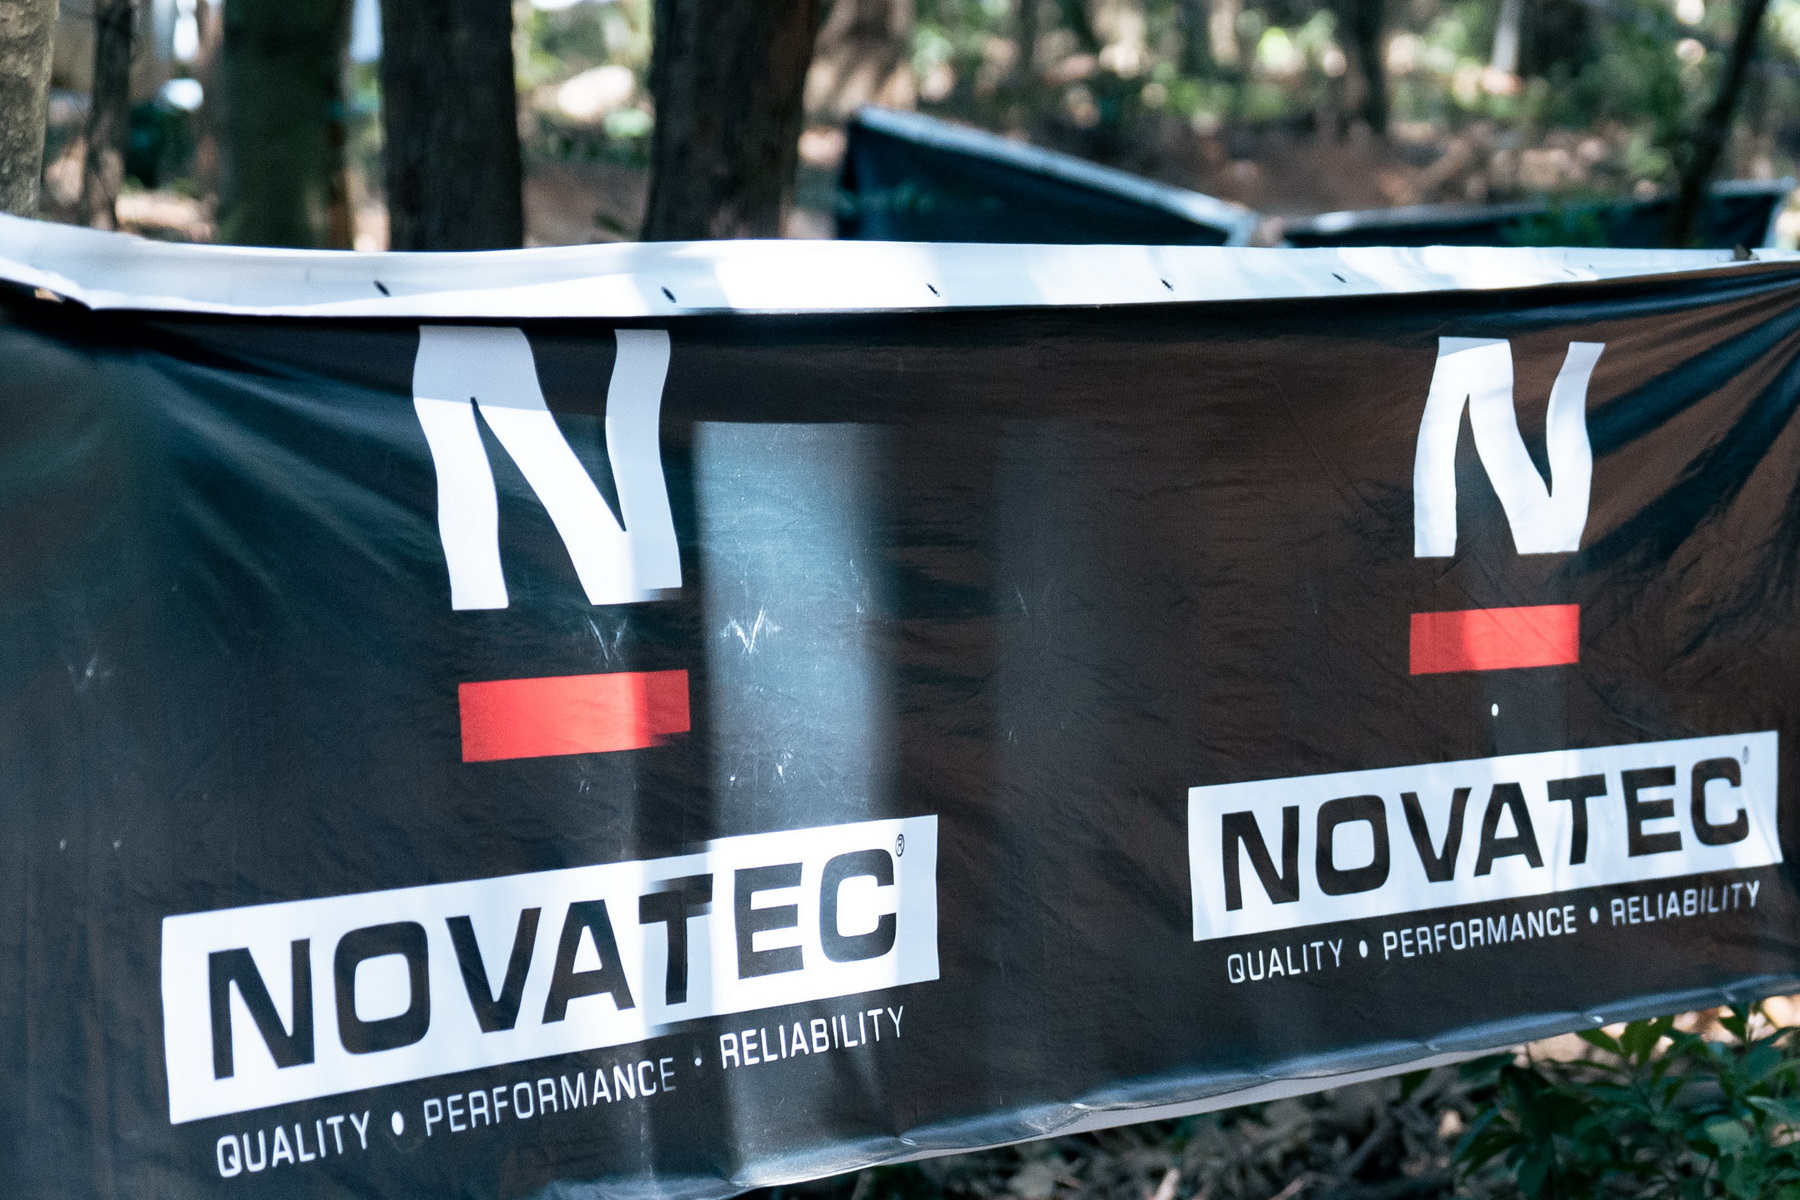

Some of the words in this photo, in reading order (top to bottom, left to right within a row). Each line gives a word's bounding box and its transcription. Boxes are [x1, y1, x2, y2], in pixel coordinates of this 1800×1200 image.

[1226, 938, 1345, 984] QUALITY
[1382, 904, 1578, 961] PERFORMANCE
[1610, 880, 1761, 927] RELIABILITY
[215, 1110, 371, 1178] QUALITY
[424, 1056, 678, 1138] PERFORMANCE
[719, 1005, 905, 1069] RELIABILITY
